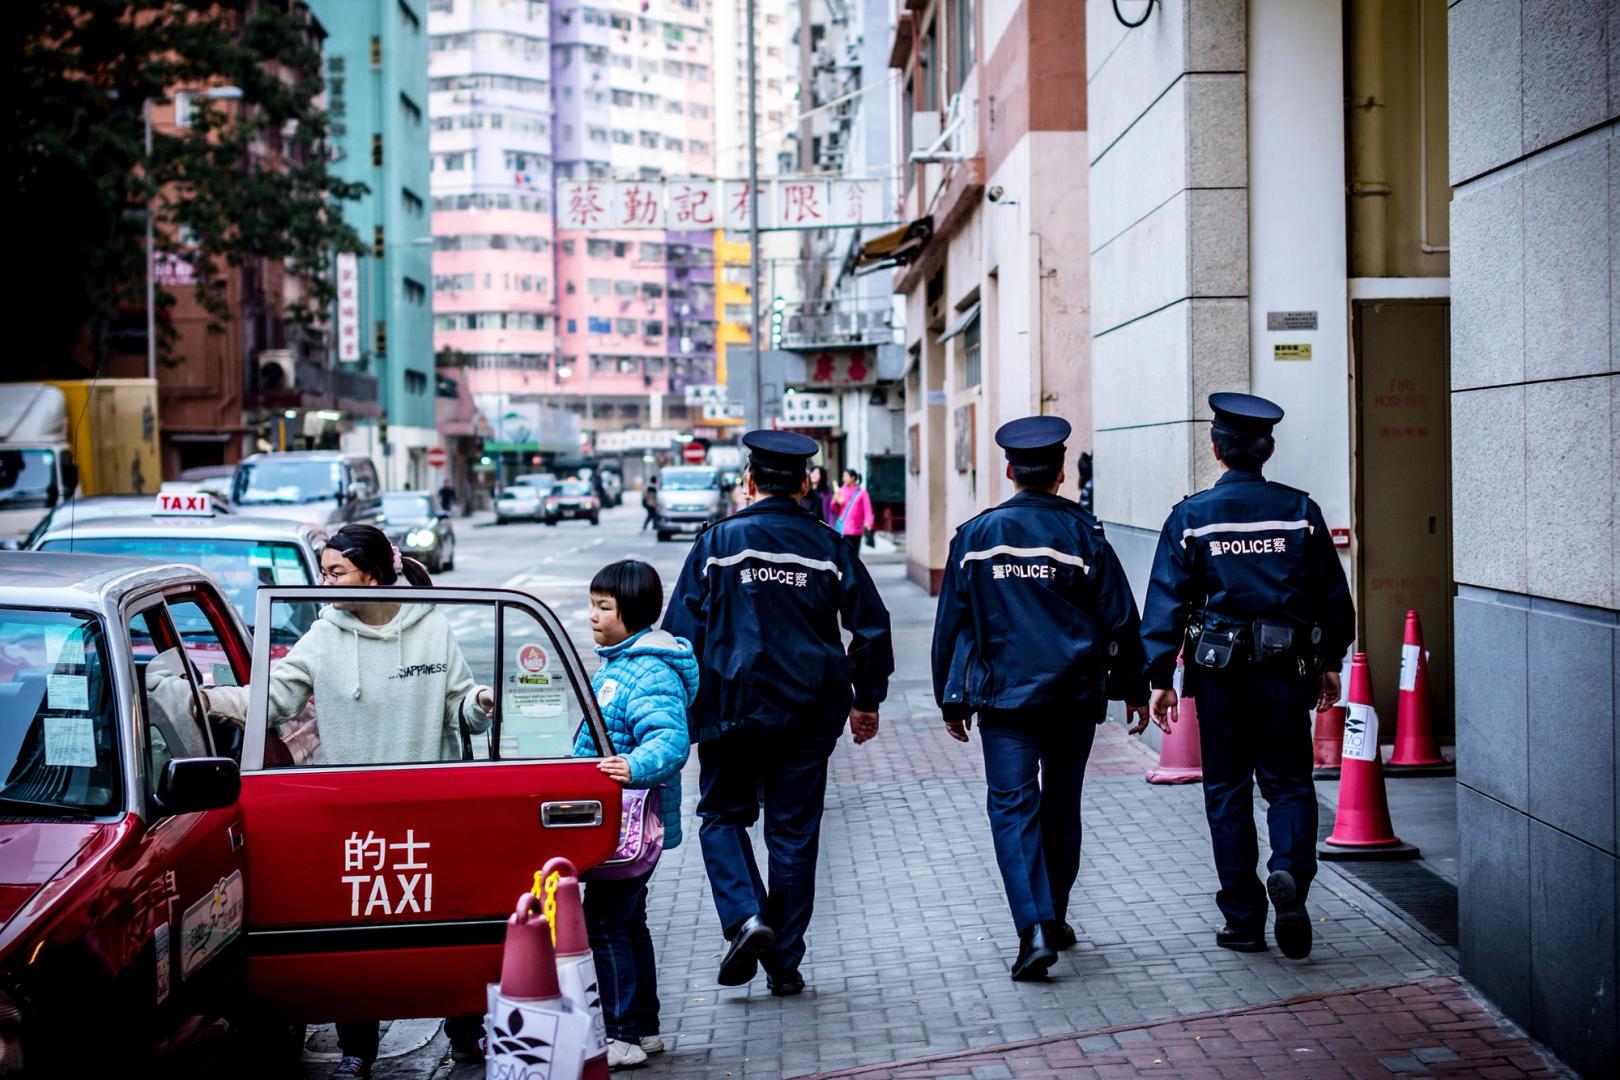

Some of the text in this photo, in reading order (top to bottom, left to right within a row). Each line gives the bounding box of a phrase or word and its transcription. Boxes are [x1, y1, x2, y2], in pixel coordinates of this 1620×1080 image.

[160, 496, 204, 511] TAXI
[740, 567, 807, 587] 警POLCE察
[345, 829, 431, 871] 的士
[341, 873, 433, 917] TAXI
